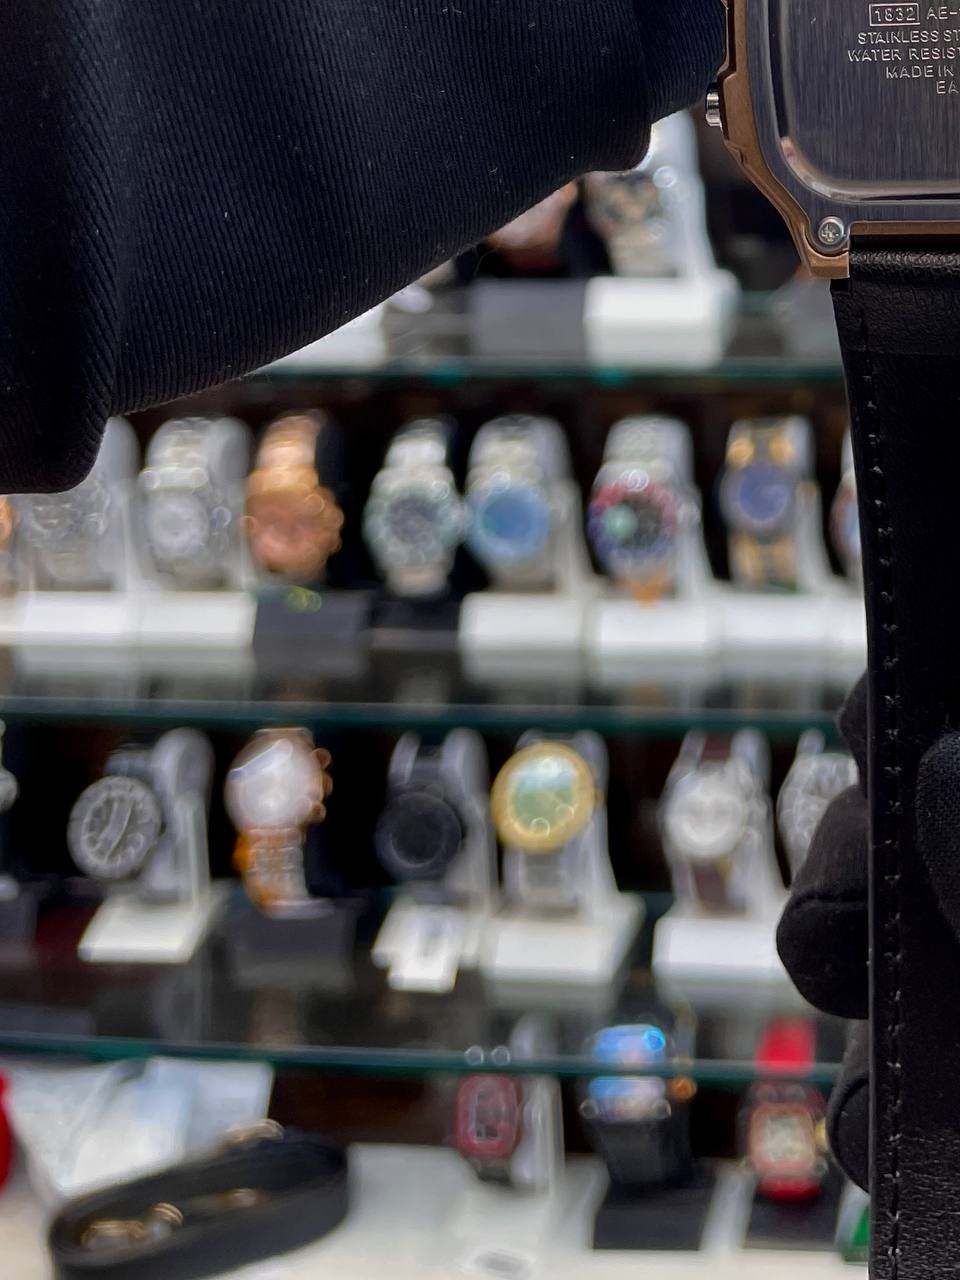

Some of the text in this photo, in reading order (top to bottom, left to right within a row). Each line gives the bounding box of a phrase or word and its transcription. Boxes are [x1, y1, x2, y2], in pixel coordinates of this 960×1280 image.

[857, 29, 939, 45] STAINLESS
[848, 49, 902, 62] WATER
[886, 65, 933, 79] MADE
[938, 65, 954, 77] IN
[936, 80, 959, 94] EA
